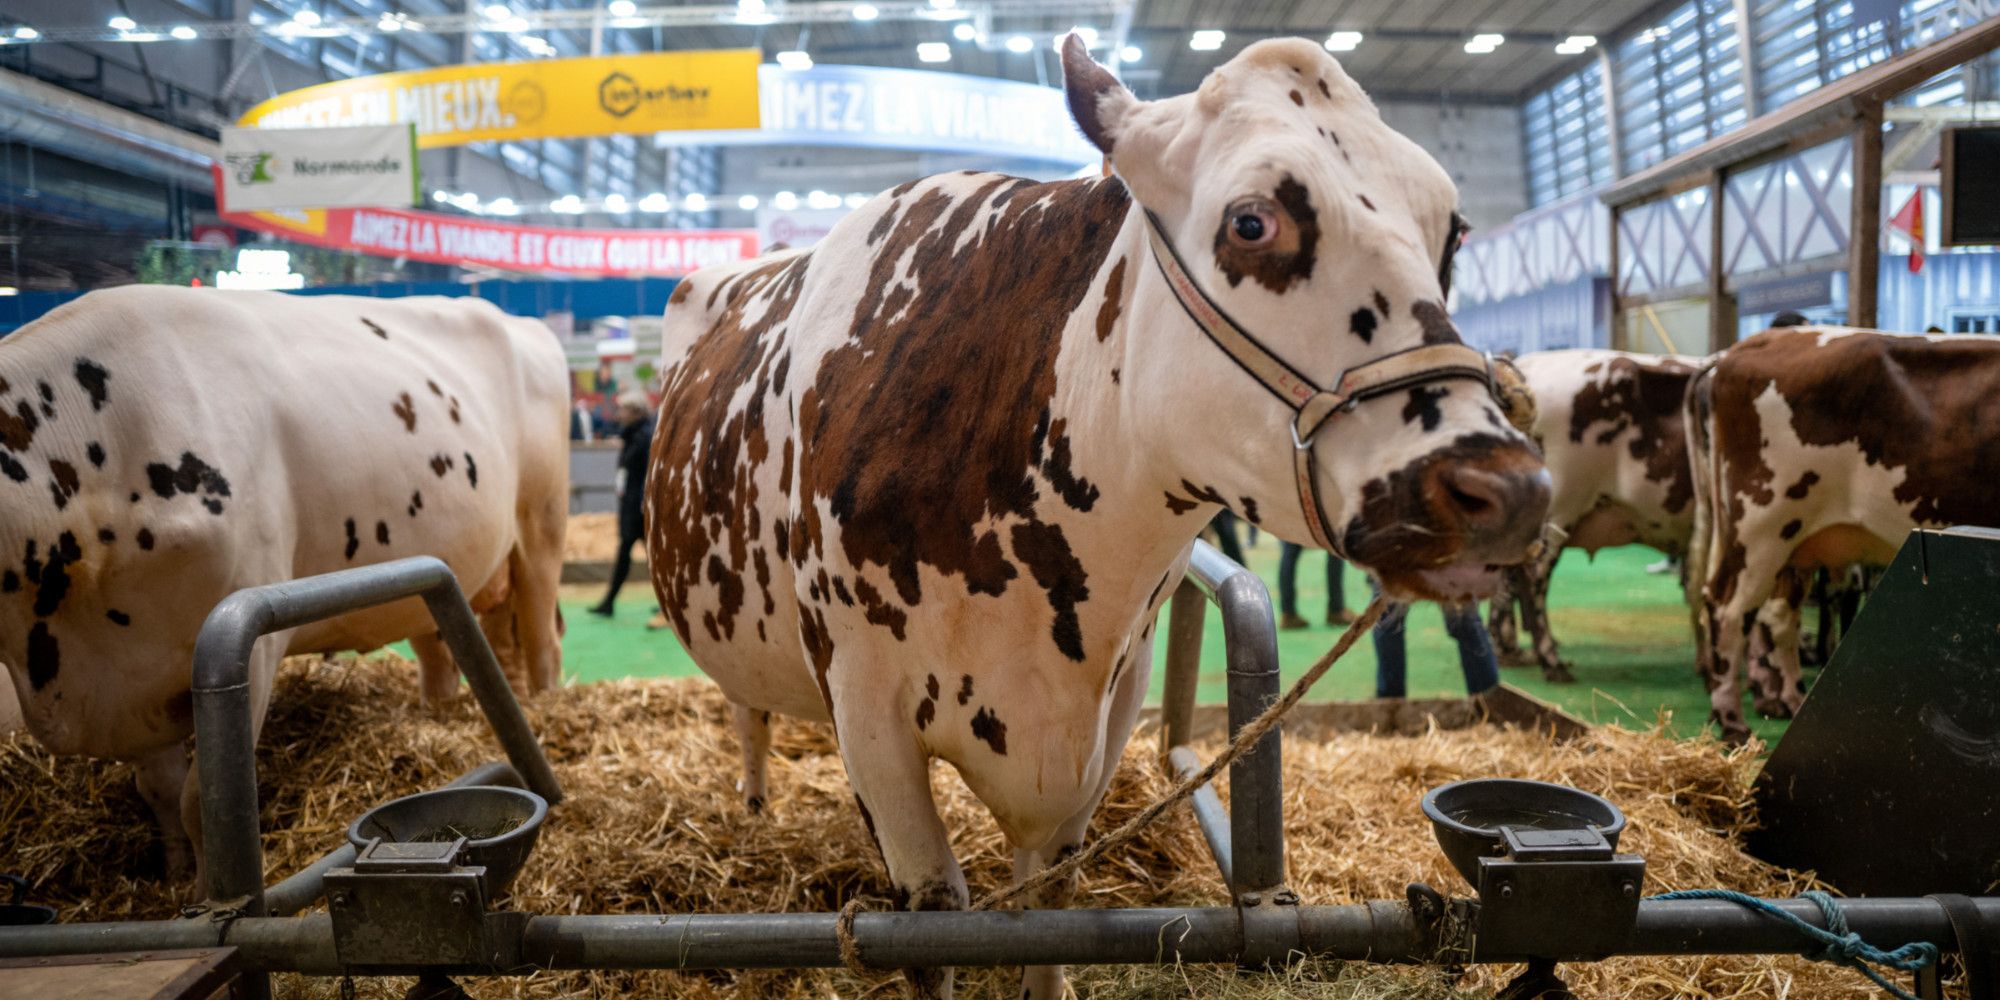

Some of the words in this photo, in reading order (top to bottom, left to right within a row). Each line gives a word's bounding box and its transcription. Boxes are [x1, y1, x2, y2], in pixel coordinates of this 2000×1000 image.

[292, 154, 401, 176] Normande
[351, 210, 408, 250] AIMEZ
[411, 220, 436, 253] LA
[438, 224, 514, 263] VIANDE
[518, 232, 545, 264] ET
[547, 235, 604, 267] CEUX
[607, 237, 649, 269] QUI
[652, 238, 681, 269] LA
